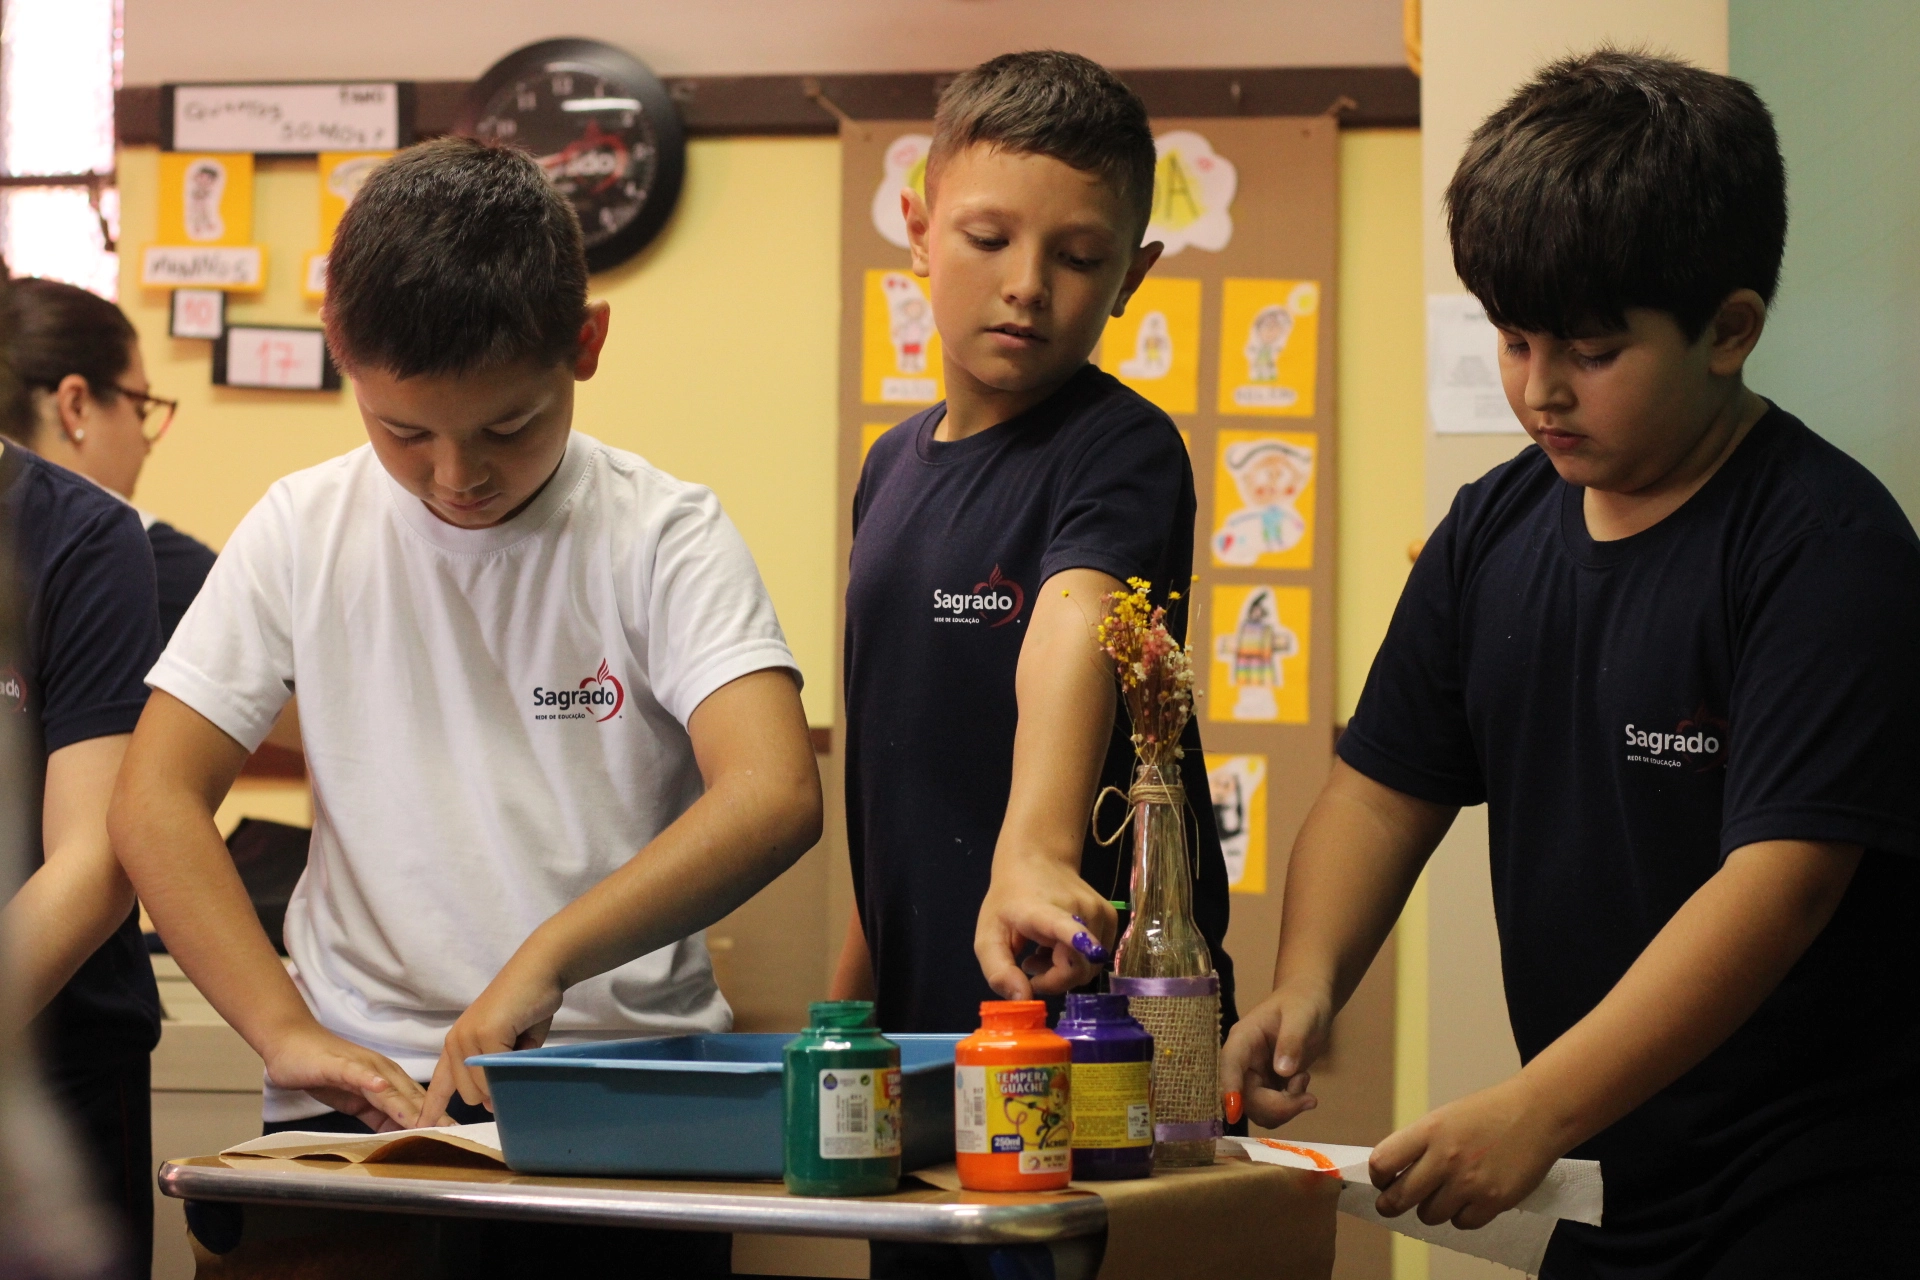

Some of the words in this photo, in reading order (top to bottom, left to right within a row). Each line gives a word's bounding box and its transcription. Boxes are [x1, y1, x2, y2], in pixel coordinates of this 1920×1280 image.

[933, 588, 1013, 614] Sagrado
[533, 686, 615, 711] Sagrado
[1625, 723, 1720, 755] Sagrado
[1650, 758, 1682, 768] EDUCAÇÃO
[996, 1071, 1049, 1084] TEMPERA
[1000, 1082, 1043, 1094] GUACHE
[994, 1136, 1021, 1147] 250ml
